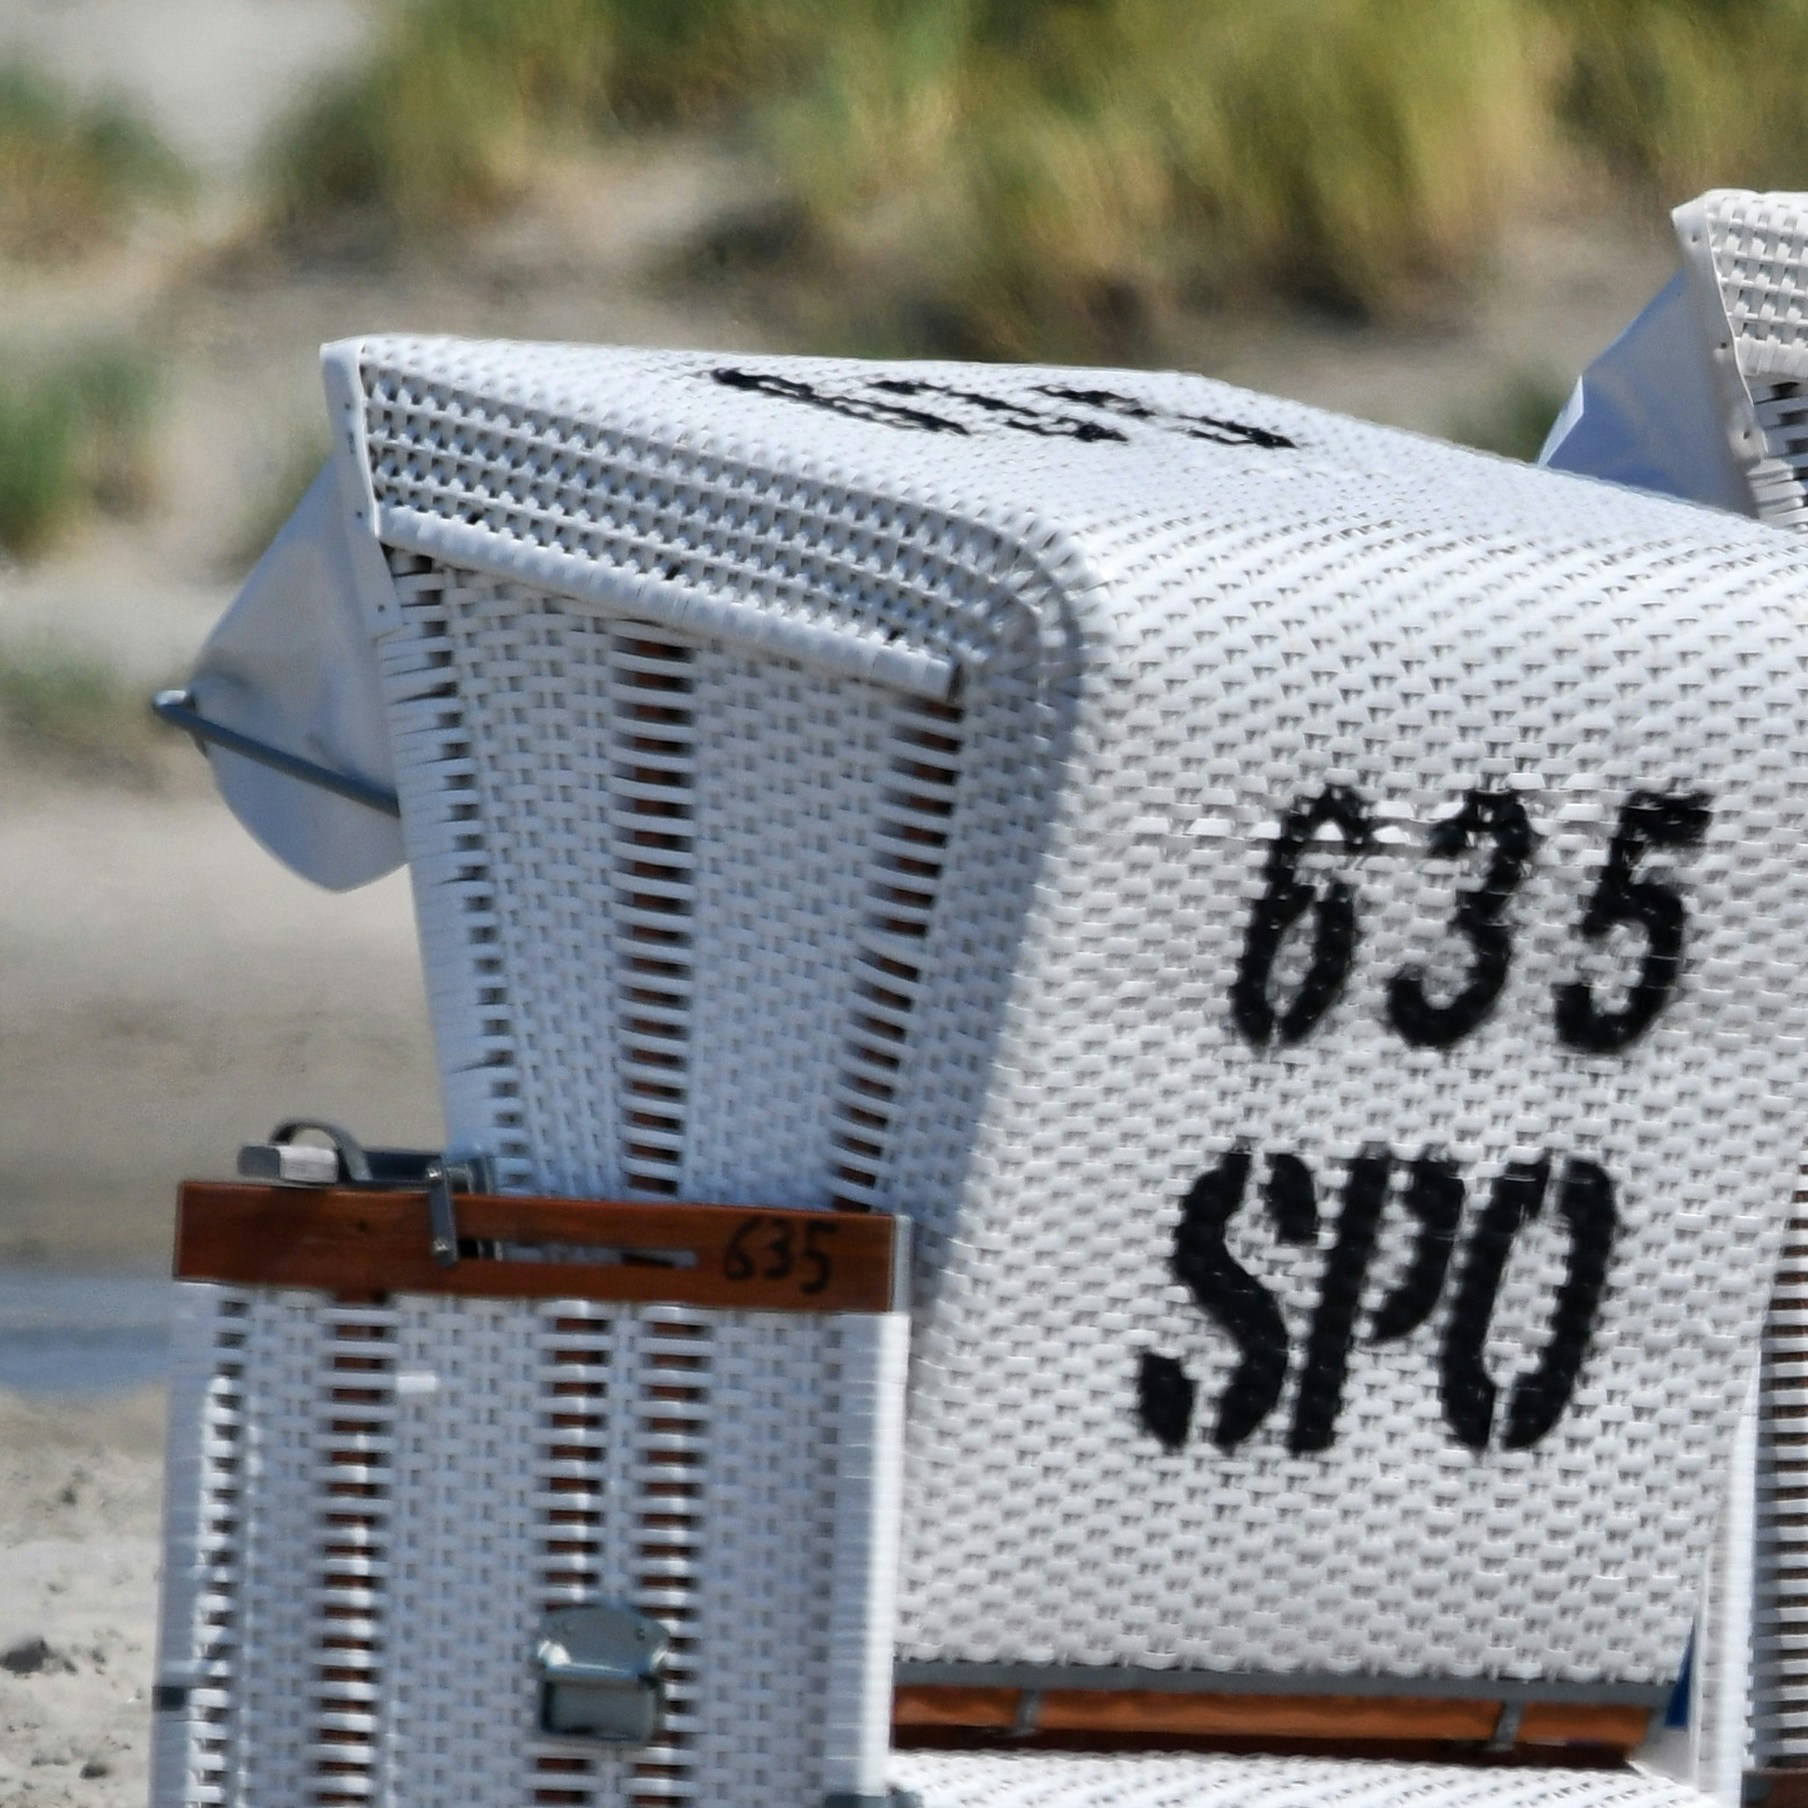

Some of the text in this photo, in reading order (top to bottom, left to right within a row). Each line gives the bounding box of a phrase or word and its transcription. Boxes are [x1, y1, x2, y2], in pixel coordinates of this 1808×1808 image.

[1230, 789, 1713, 1053] 635
[723, 1215, 840, 1295] 635
[1137, 1140, 1619, 1452] SPO
